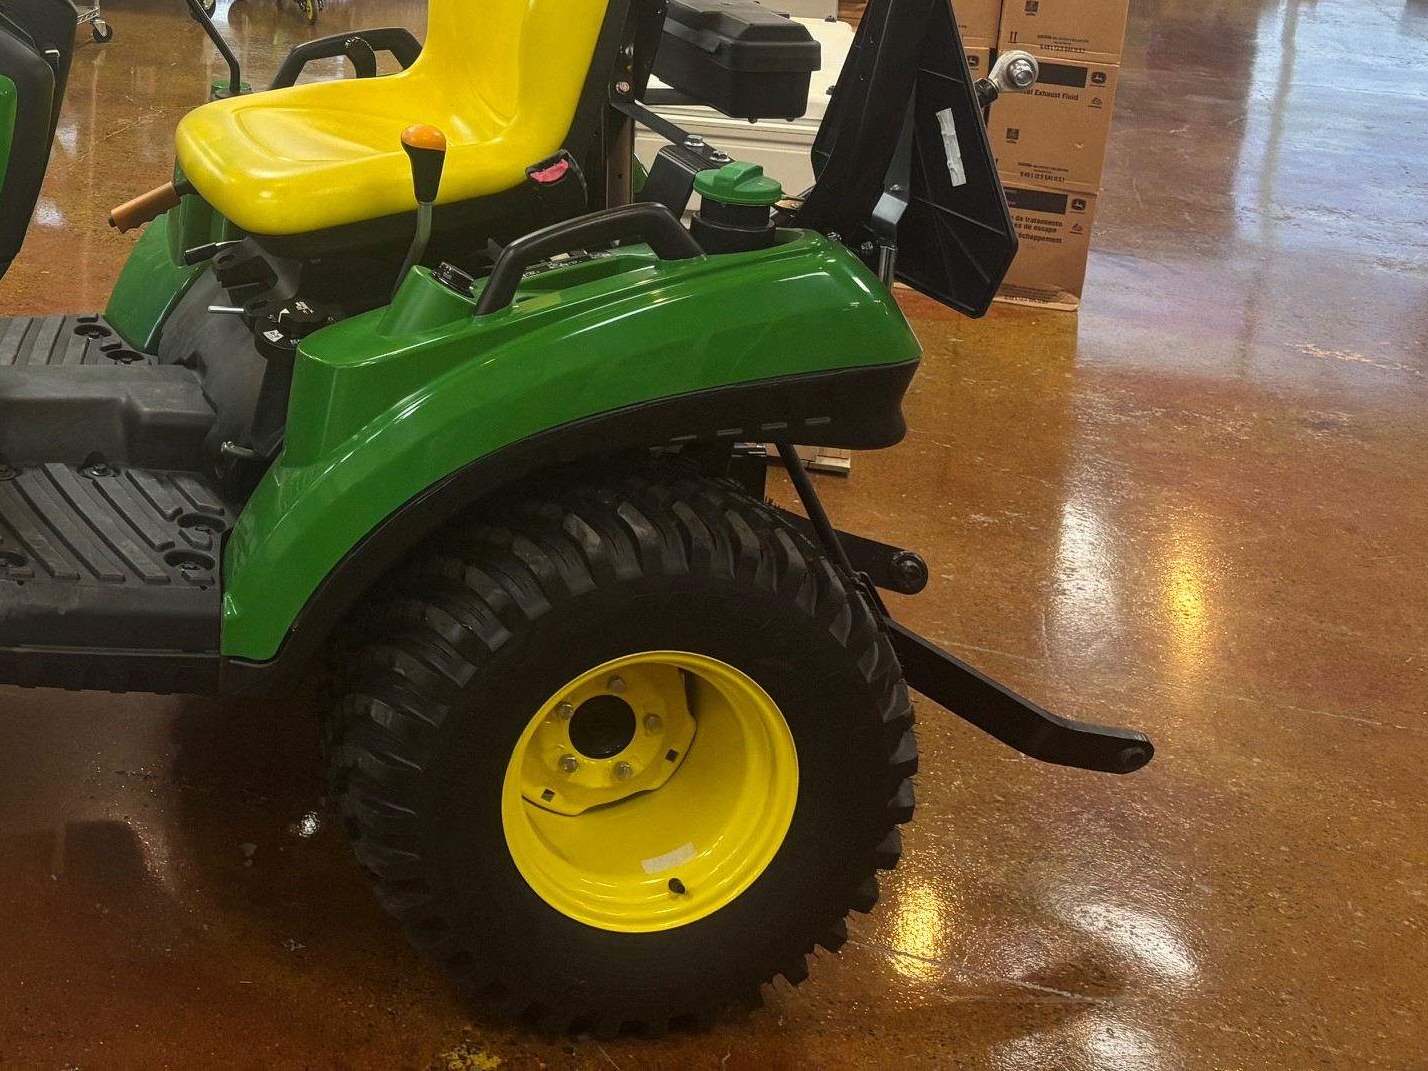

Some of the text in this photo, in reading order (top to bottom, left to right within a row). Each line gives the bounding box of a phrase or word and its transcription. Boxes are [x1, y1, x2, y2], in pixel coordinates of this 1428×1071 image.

[1034, 90, 1060, 98] Exhaust
[1025, 217, 1063, 227] tratamiento
[1034, 224, 1057, 234] escape
[1017, 232, 1062, 244] 'échappement
